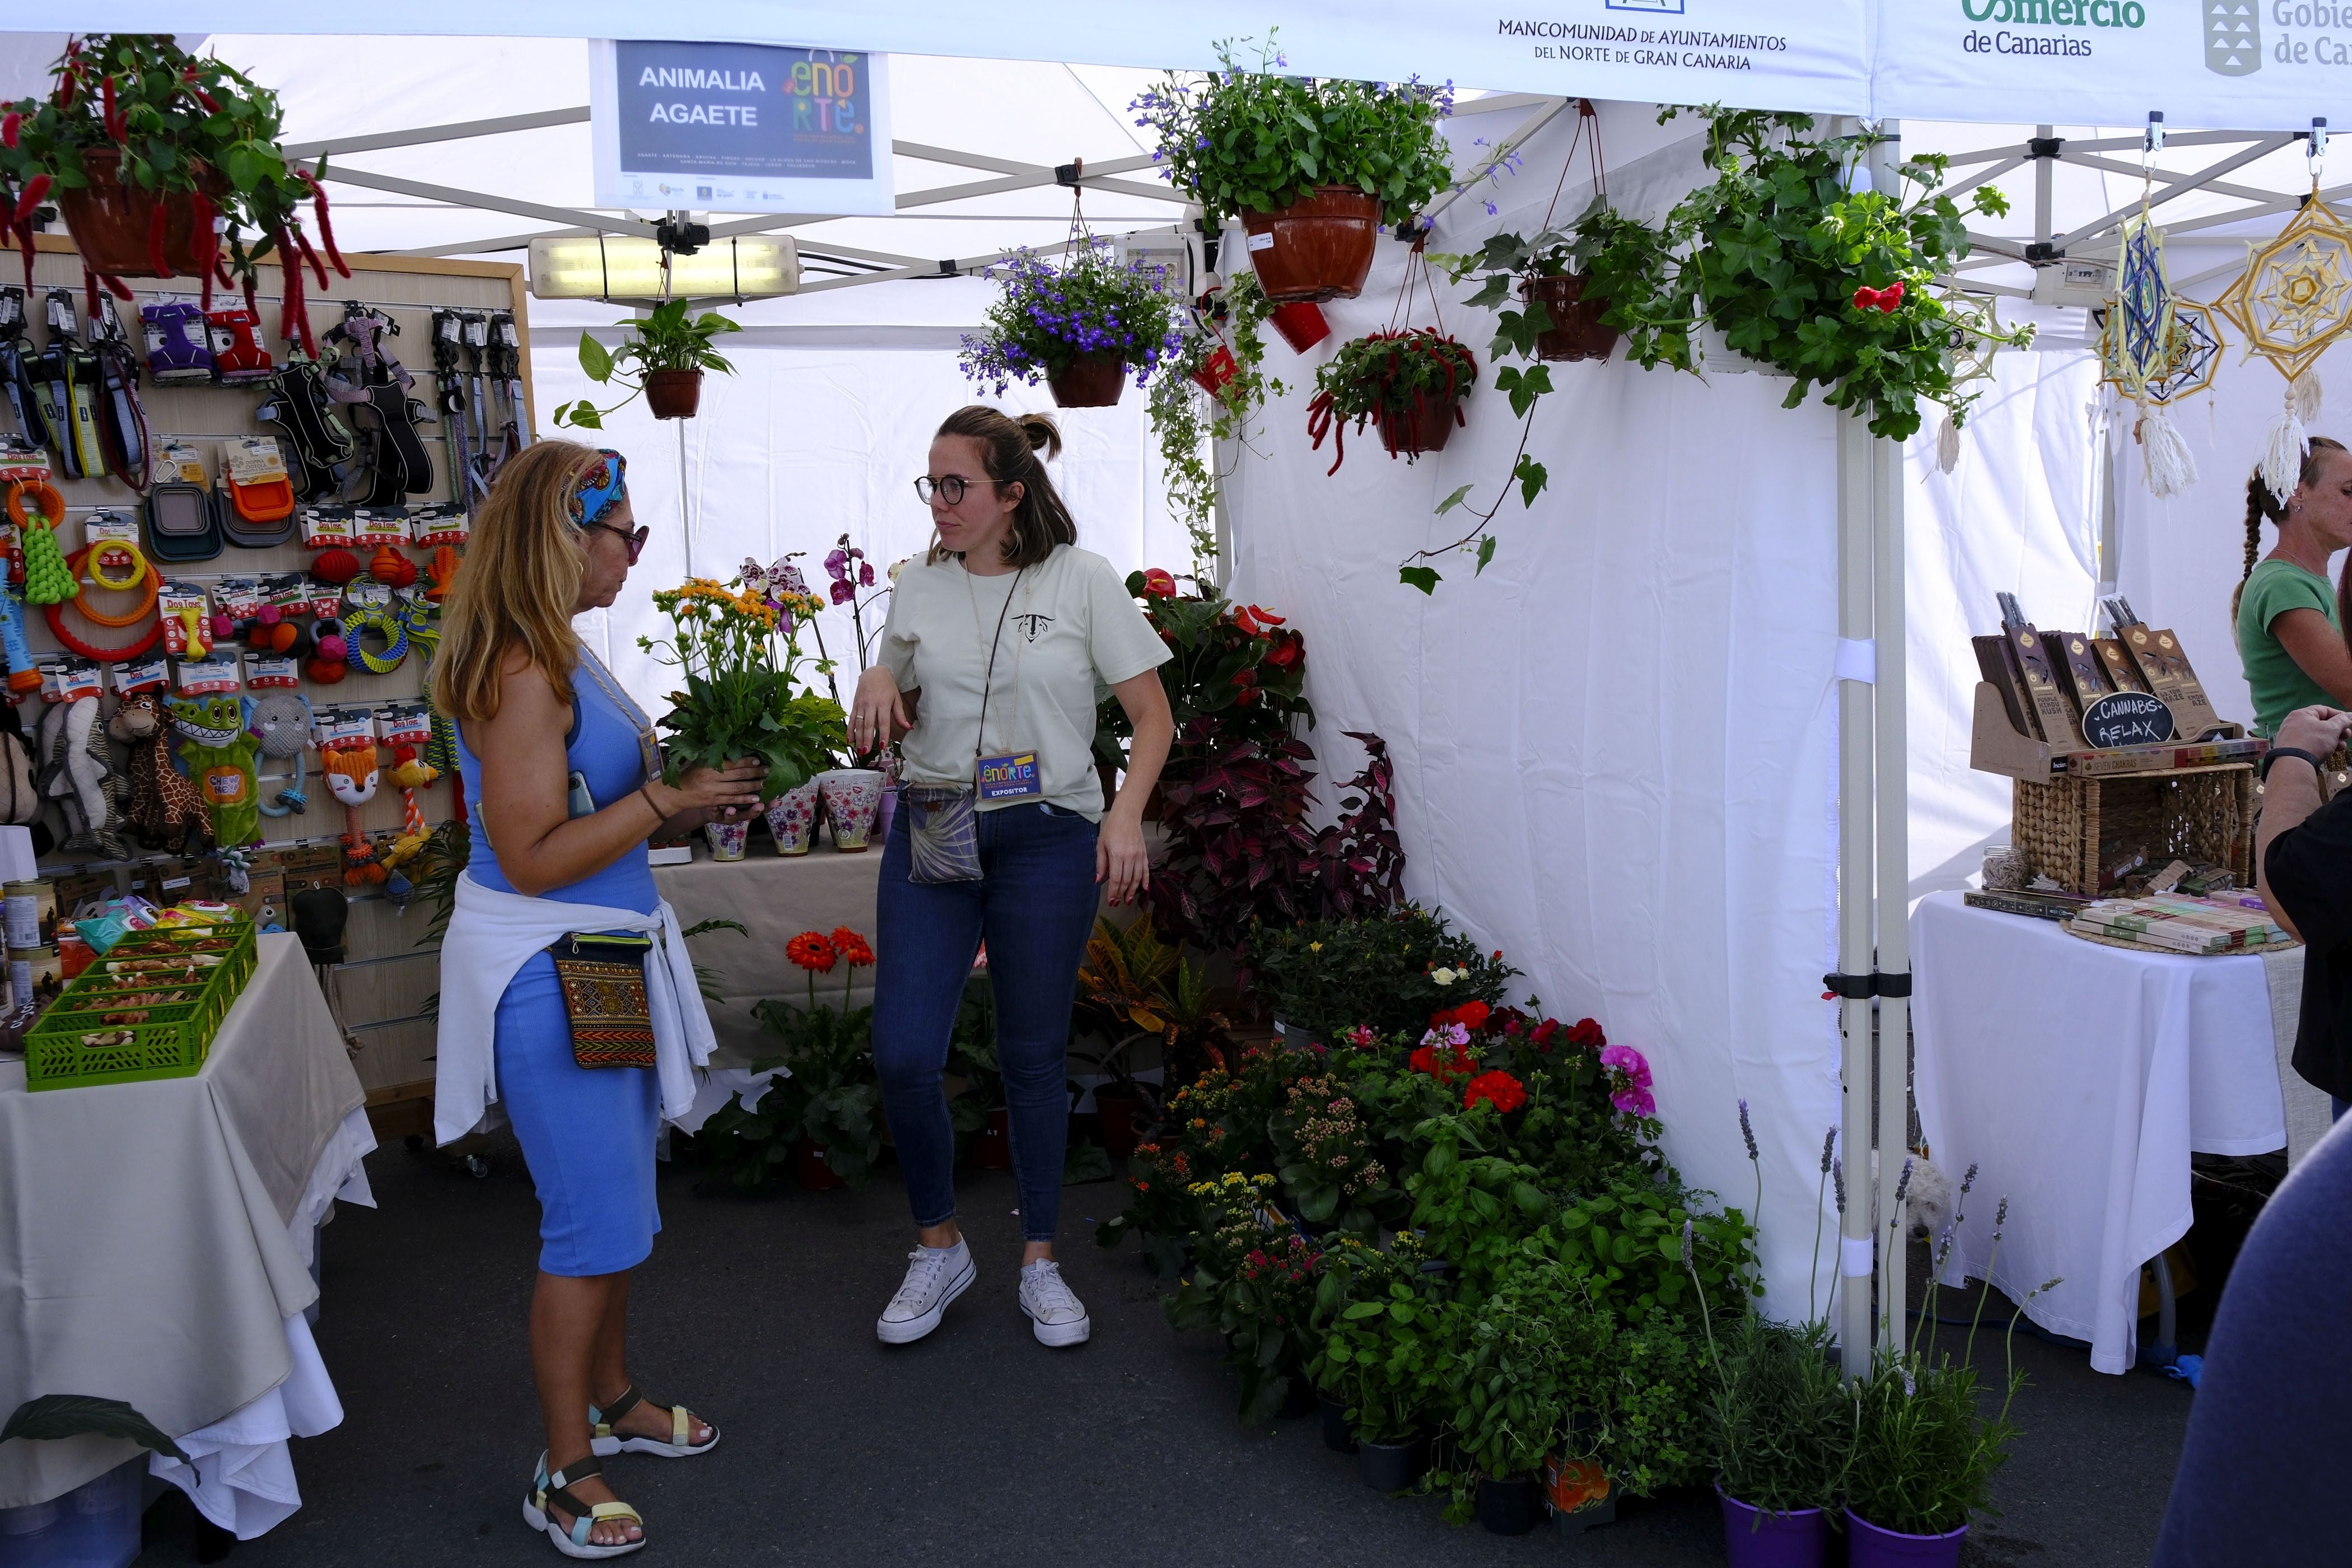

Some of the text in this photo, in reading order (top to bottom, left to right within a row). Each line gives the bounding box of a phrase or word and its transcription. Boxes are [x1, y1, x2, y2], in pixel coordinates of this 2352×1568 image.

[1498, 19, 1637, 43] MANCOMUNIDAD
[1658, 30, 1786, 52] AYUNTAMIENTOS
[1963, 30, 2092, 57] de Canarias
[2274, 34, 2308, 64] de
[1534, 45, 1556, 59] DEL
[1560, 45, 1611, 62] NORTE
[1634, 50, 1678, 67] GRAN
[1682, 53, 1751, 71] CANARIA
[639, 67, 766, 92] ANIMALIA
[650, 102, 758, 127] AGAETE
[319, 521, 330, 530] Dog
[330, 521, 342, 529] Toys
[369, 520, 396, 529] Dog Toys
[270, 590, 295, 601] Dog Toys
[167, 599, 200, 609] Dog Toys
[68, 674, 80, 683] Dog
[129, 671, 143, 680] Dog
[2163, 693, 2184, 703] HAZE
[2041, 707, 2062, 715] KUSH
[2099, 720, 2160, 747] RELAX
[2093, 761, 2111, 771] SEVEN
[2112, 759, 2137, 770] CHAKRAS
[208, 774, 240, 786] CHEW
[992, 787, 1028, 796] EXPOSITOR
[2113, 862, 2132, 878] LIMPIEZA
